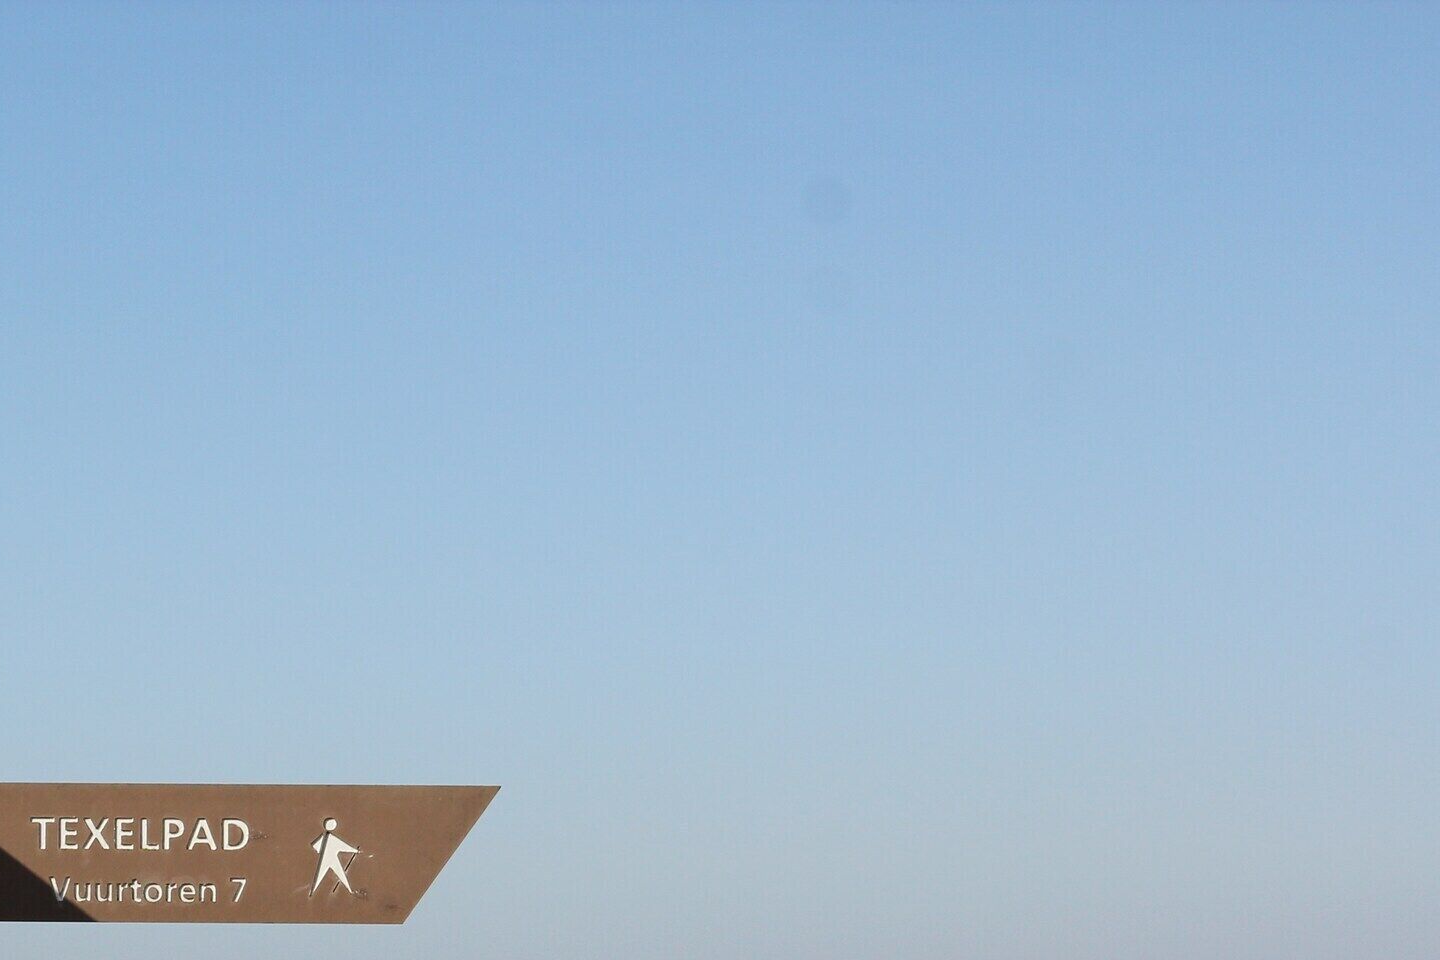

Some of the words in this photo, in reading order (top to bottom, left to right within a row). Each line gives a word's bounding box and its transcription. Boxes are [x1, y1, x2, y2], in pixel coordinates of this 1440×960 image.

[31, 816, 250, 852] TEXELPAD
[50, 876, 218, 904] Vuurtoren
[230, 877, 247, 904] 7
